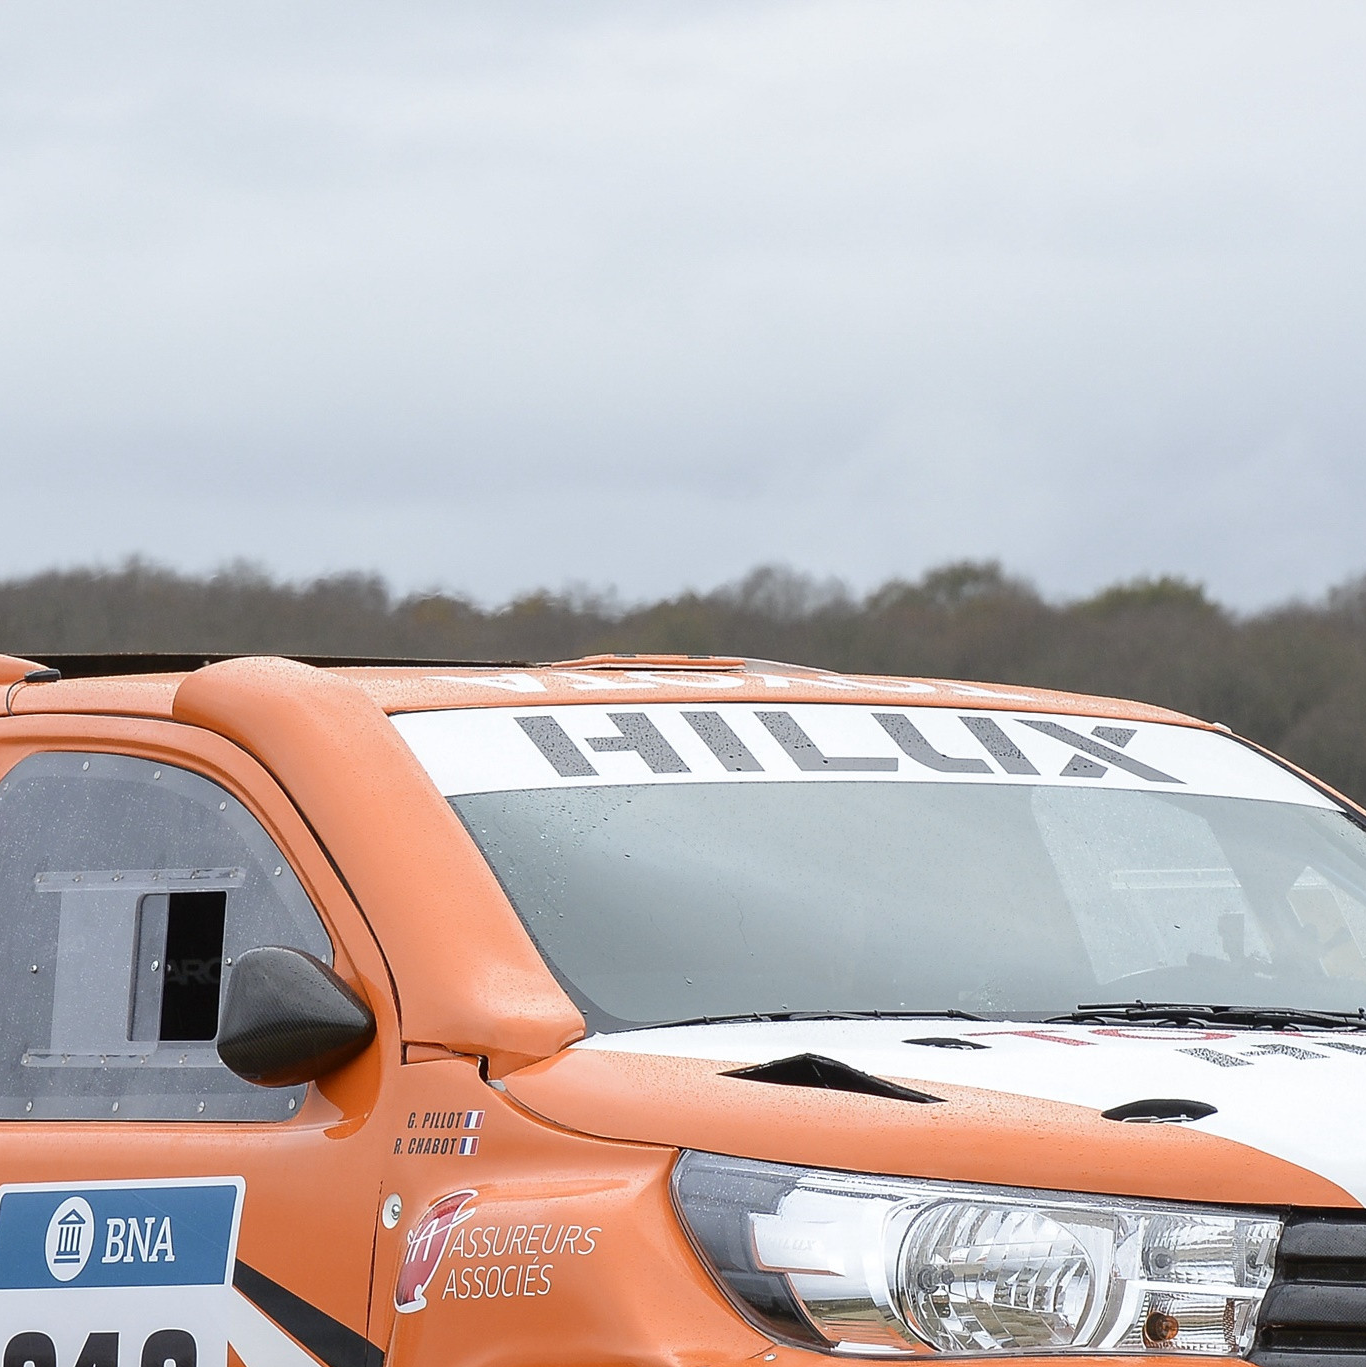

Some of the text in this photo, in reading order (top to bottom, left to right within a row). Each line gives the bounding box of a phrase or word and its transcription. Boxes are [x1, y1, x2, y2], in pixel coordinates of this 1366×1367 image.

[514, 710, 1187, 784] HILUX
[407, 1111, 463, 1129] G. PILLOT
[393, 1137, 457, 1155] R. CHABOT
[101, 1216, 176, 1264] BNA
[447, 1223, 603, 1259] ASSUREURS
[441, 1255, 555, 1300] ASSOCIÉS
